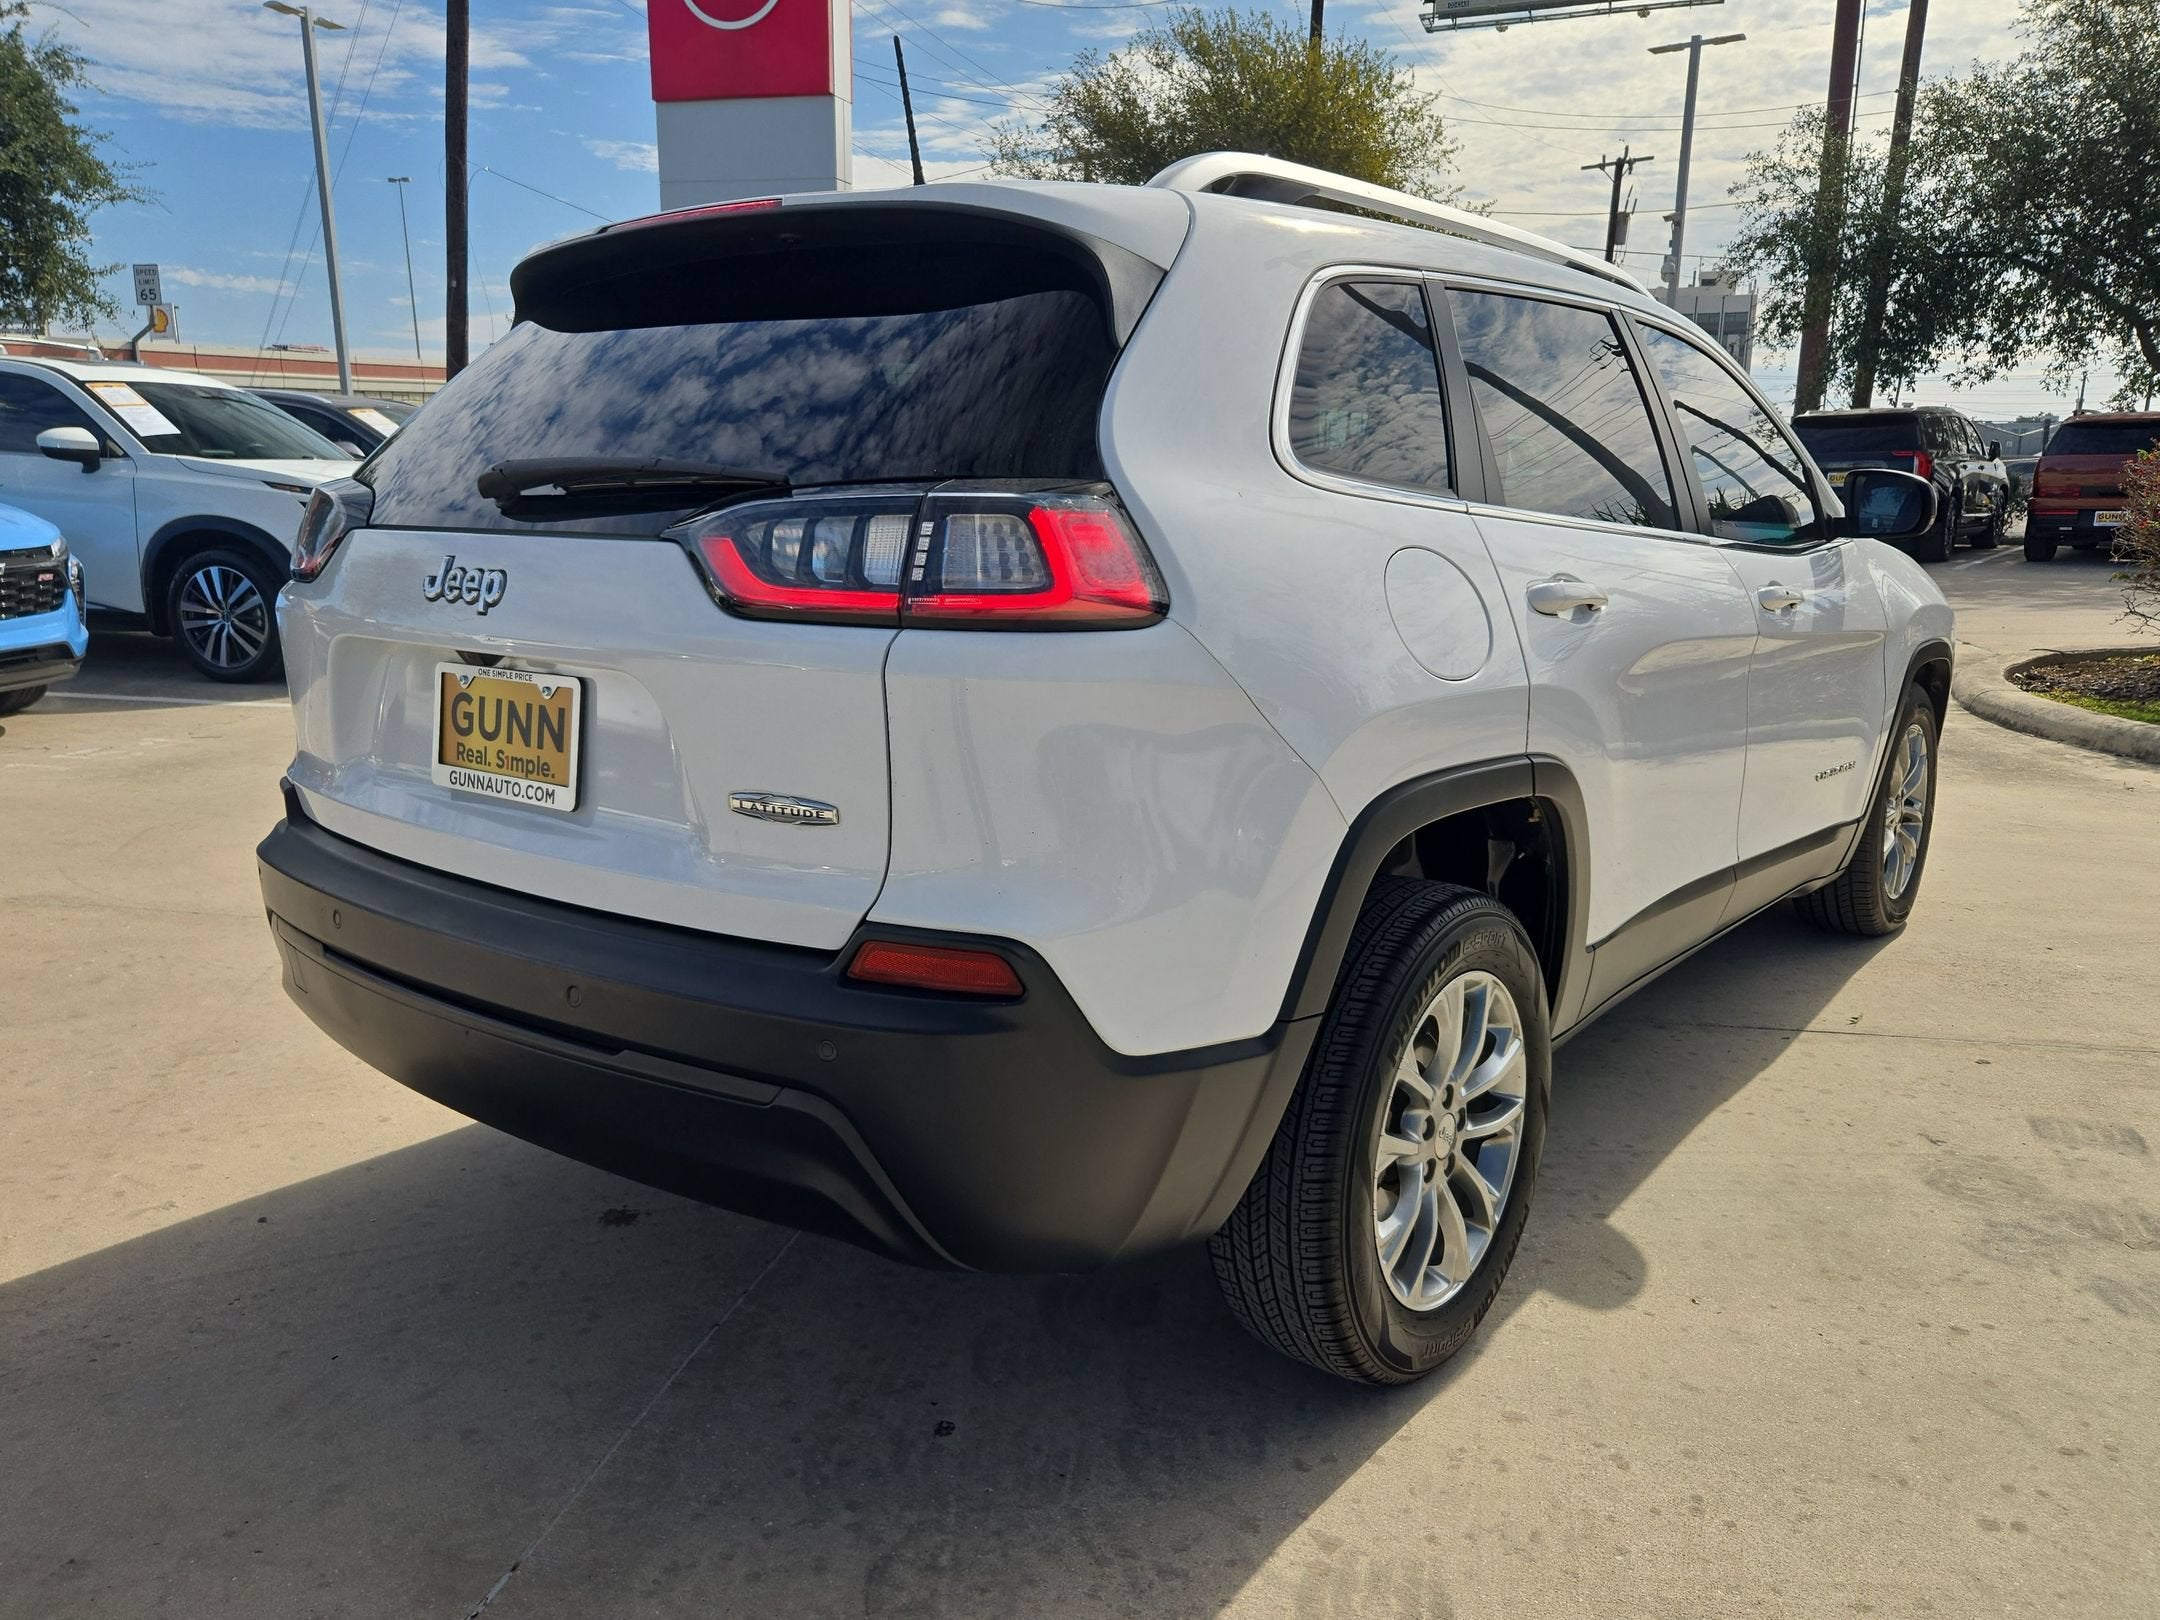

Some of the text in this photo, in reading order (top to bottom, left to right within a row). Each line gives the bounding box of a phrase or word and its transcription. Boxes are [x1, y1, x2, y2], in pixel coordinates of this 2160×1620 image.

[135, 268, 157, 276] SPEED
[138, 278, 155, 286] LIMIT
[140, 288, 157, 301] 65
[423, 555, 508, 616] Jeep
[477, 668, 533, 682] ONE SIMPLE PRICE
[451, 691, 566, 753] GUNN
[456, 742, 492, 767] Real.
[449, 770, 556, 805] GUNNAUTO.COM
[739, 799, 826, 819] LATITUDE
